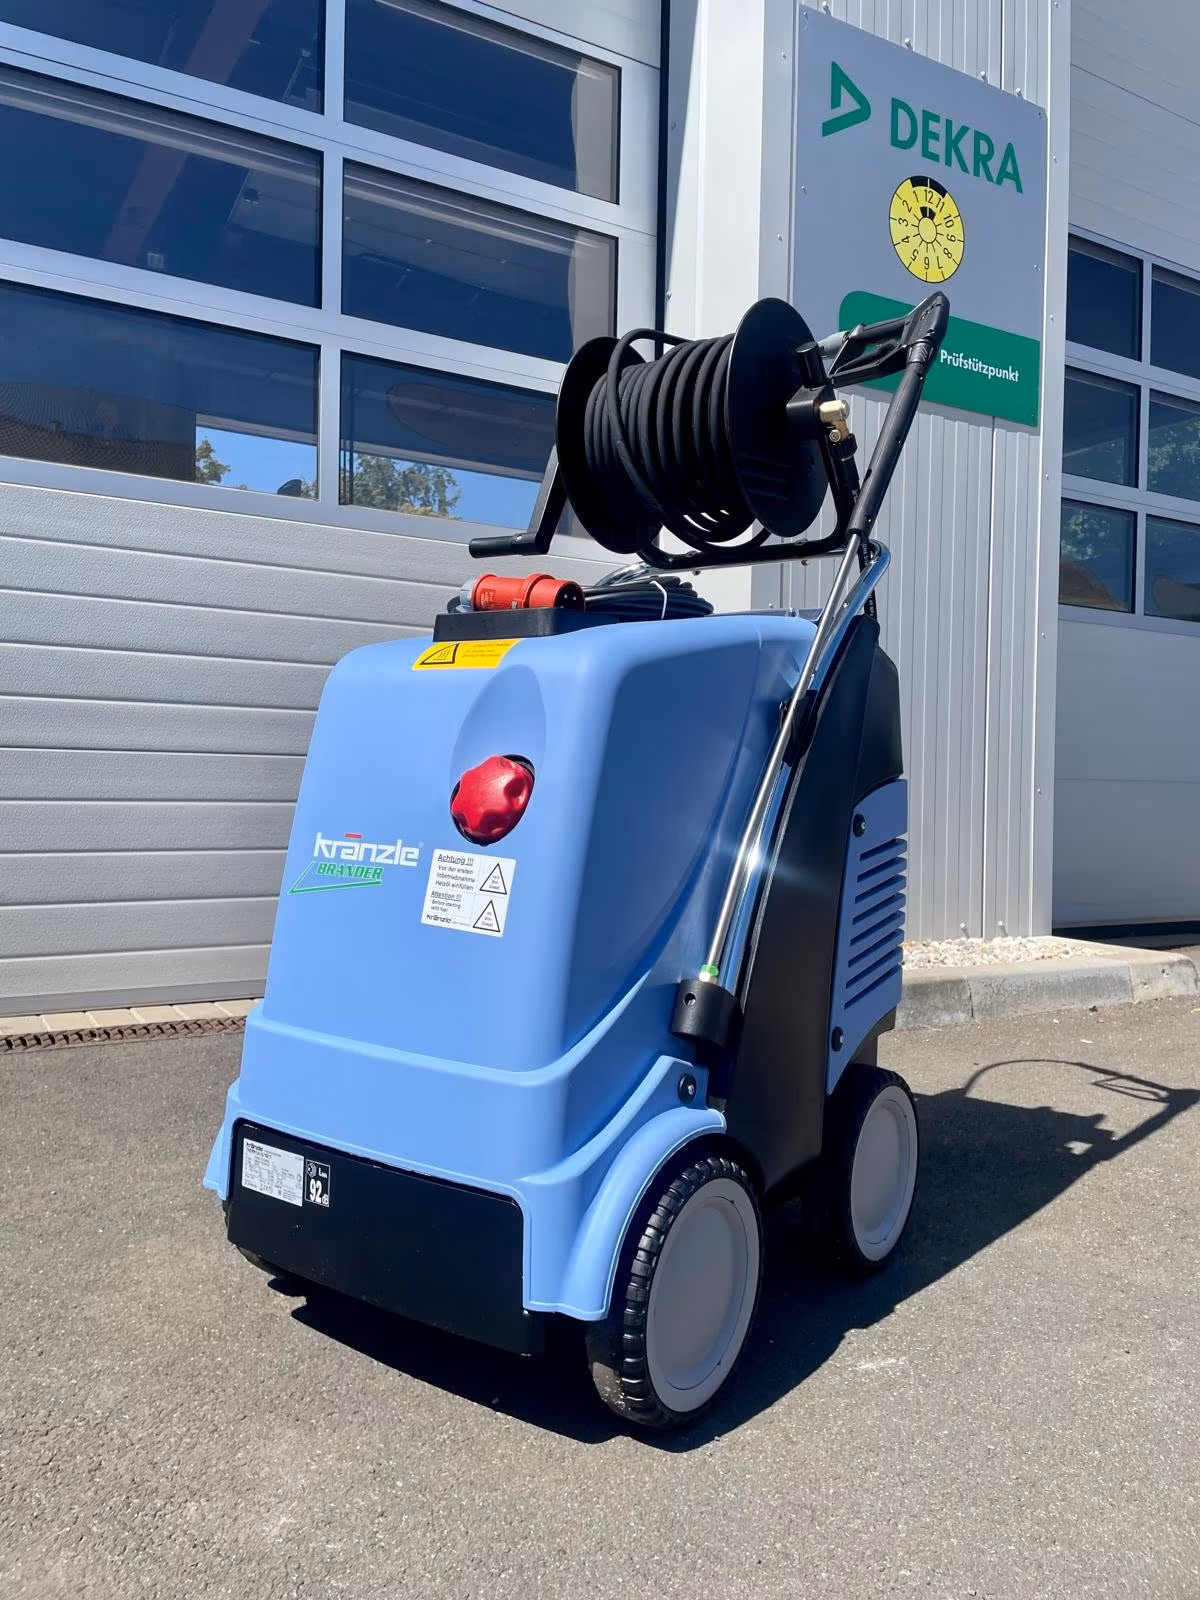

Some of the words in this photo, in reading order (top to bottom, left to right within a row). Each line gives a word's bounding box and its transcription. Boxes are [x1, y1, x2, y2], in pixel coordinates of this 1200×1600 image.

[890, 97, 1024, 194] DEKRA
[913, 191, 919, 203] 1
[924, 190, 934, 204] 12
[902, 199, 913, 213] 2
[935, 198, 945, 212] 11
[898, 218, 909, 227] 3
[944, 214, 955, 229] 10
[901, 235, 910, 244] 4
[910, 248, 919, 262] 5
[943, 248, 953, 259] 8
[940, 349, 1019, 382] Prüfstützpunkt
[437, 854, 466, 866] Achtung
[310, 1178, 322, 1204] 92
